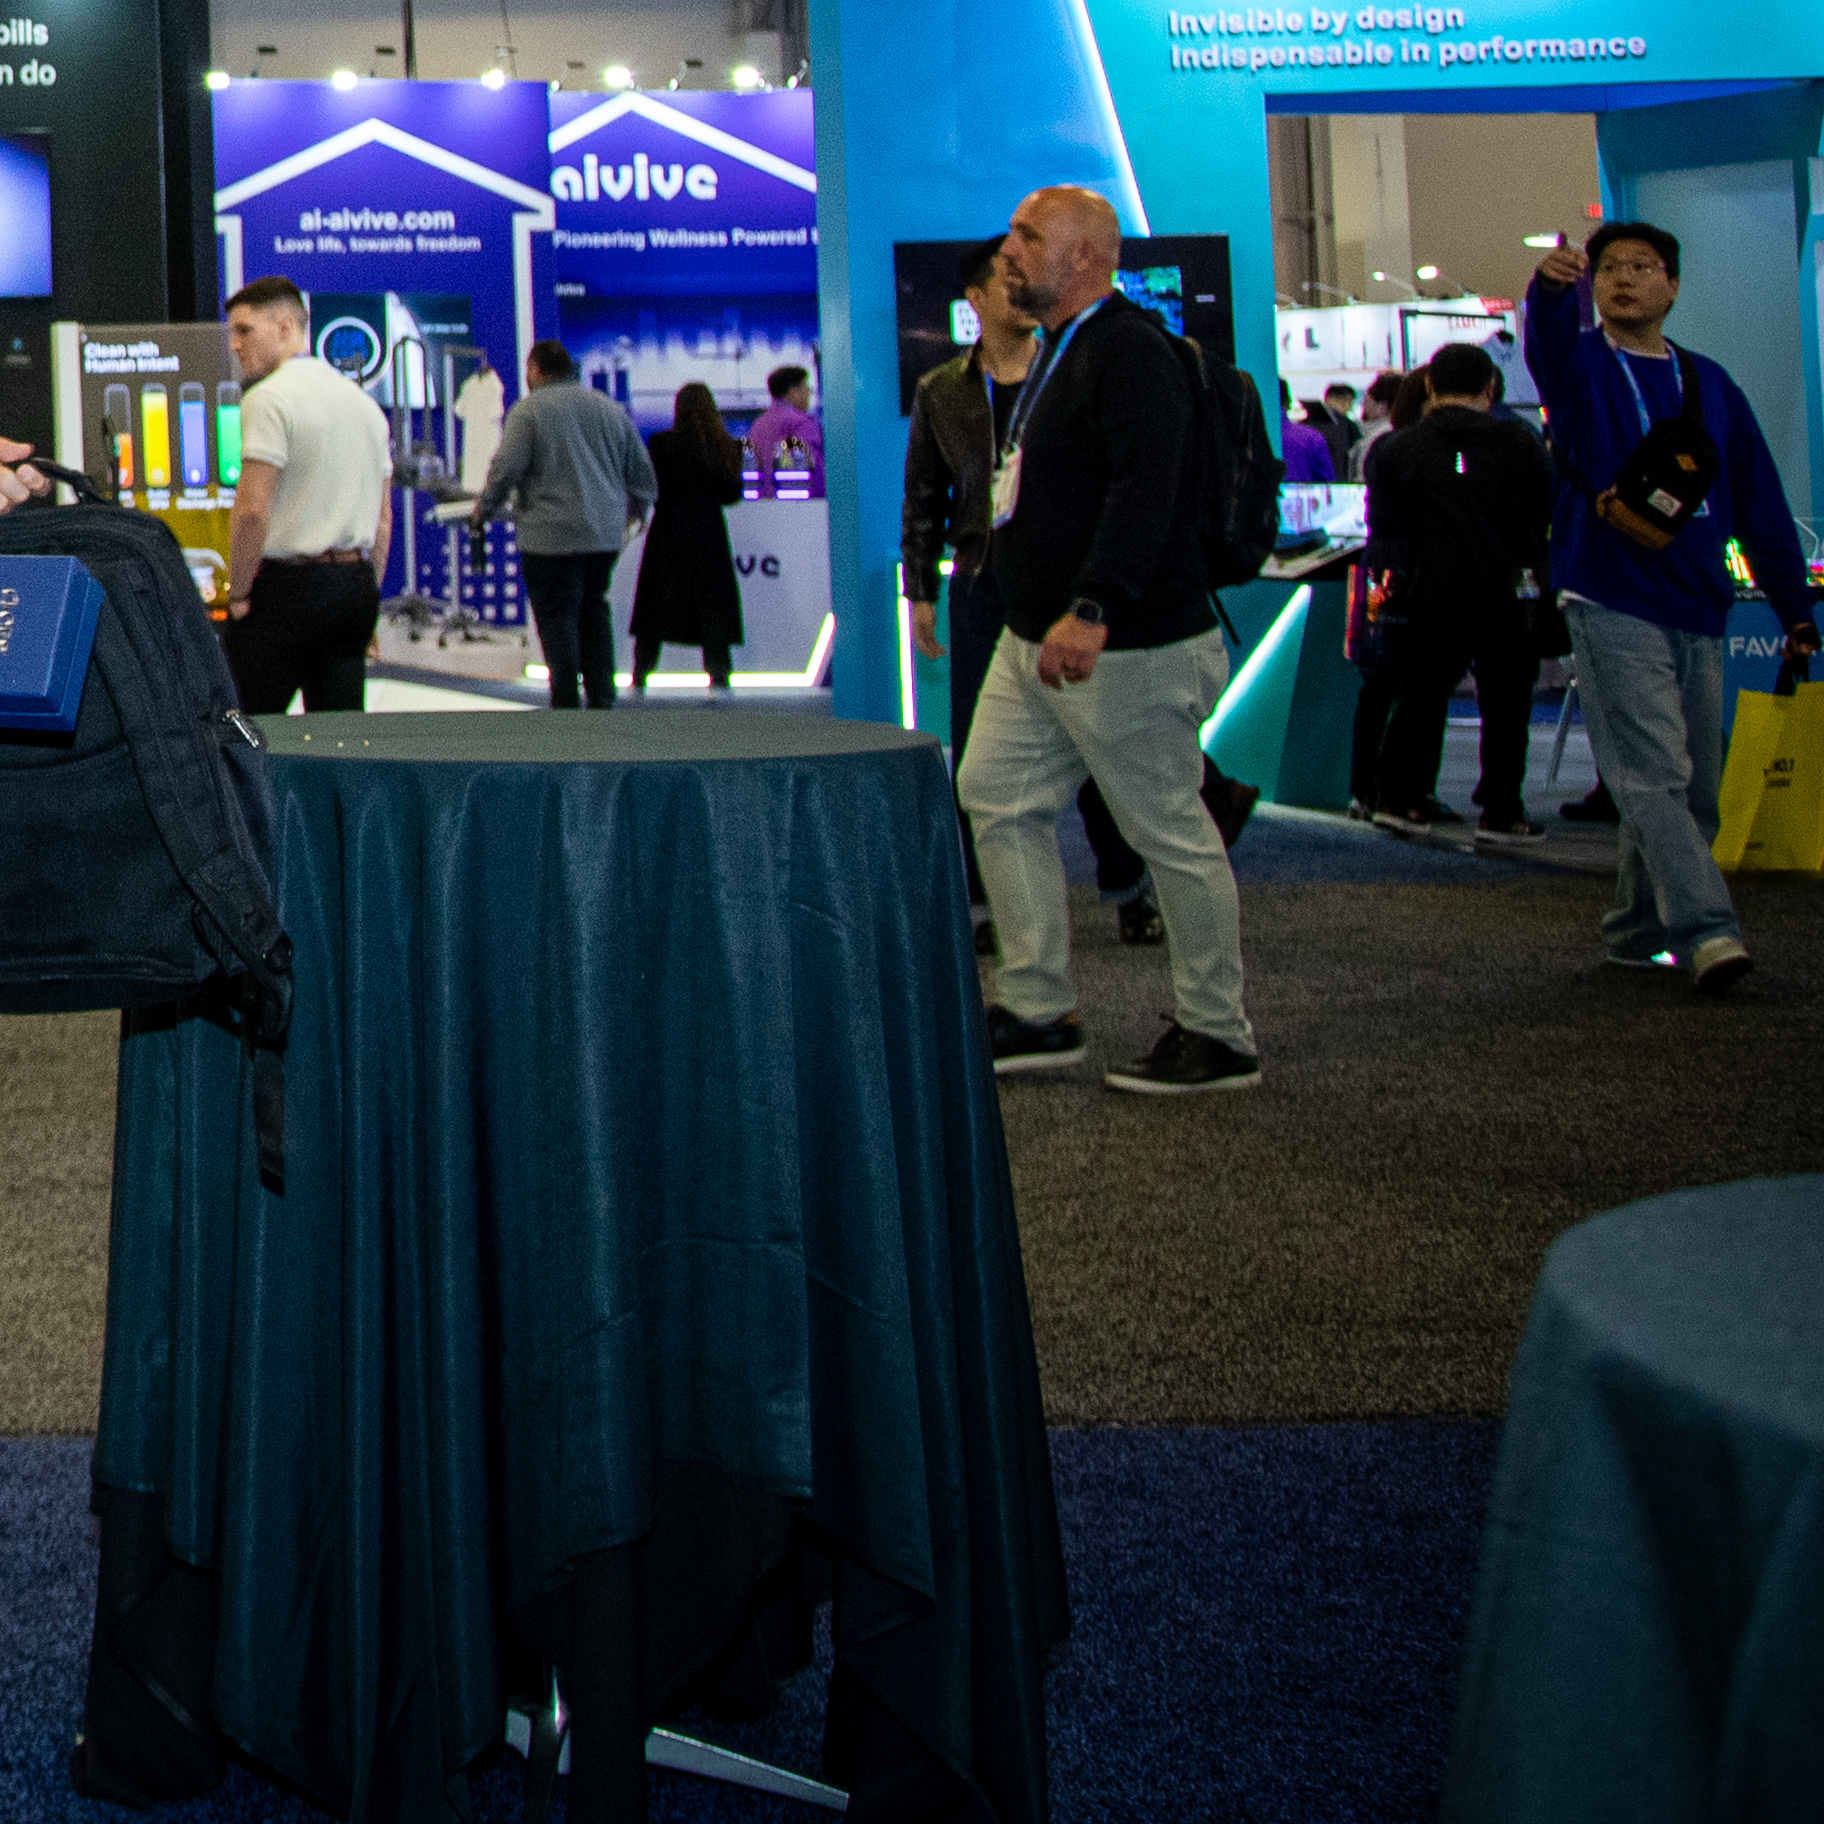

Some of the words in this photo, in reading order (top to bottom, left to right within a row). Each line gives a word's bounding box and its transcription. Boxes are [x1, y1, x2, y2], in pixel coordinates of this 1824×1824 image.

[1167, 9, 1303, 37] Invisible
[1310, 6, 1348, 36] by
[1355, 2, 1466, 35] design
[1171, 41, 1394, 74] Indispensable
[1400, 38, 1432, 64] in
[1438, 34, 1648, 68] performance
[18, 57, 58, 87] do
